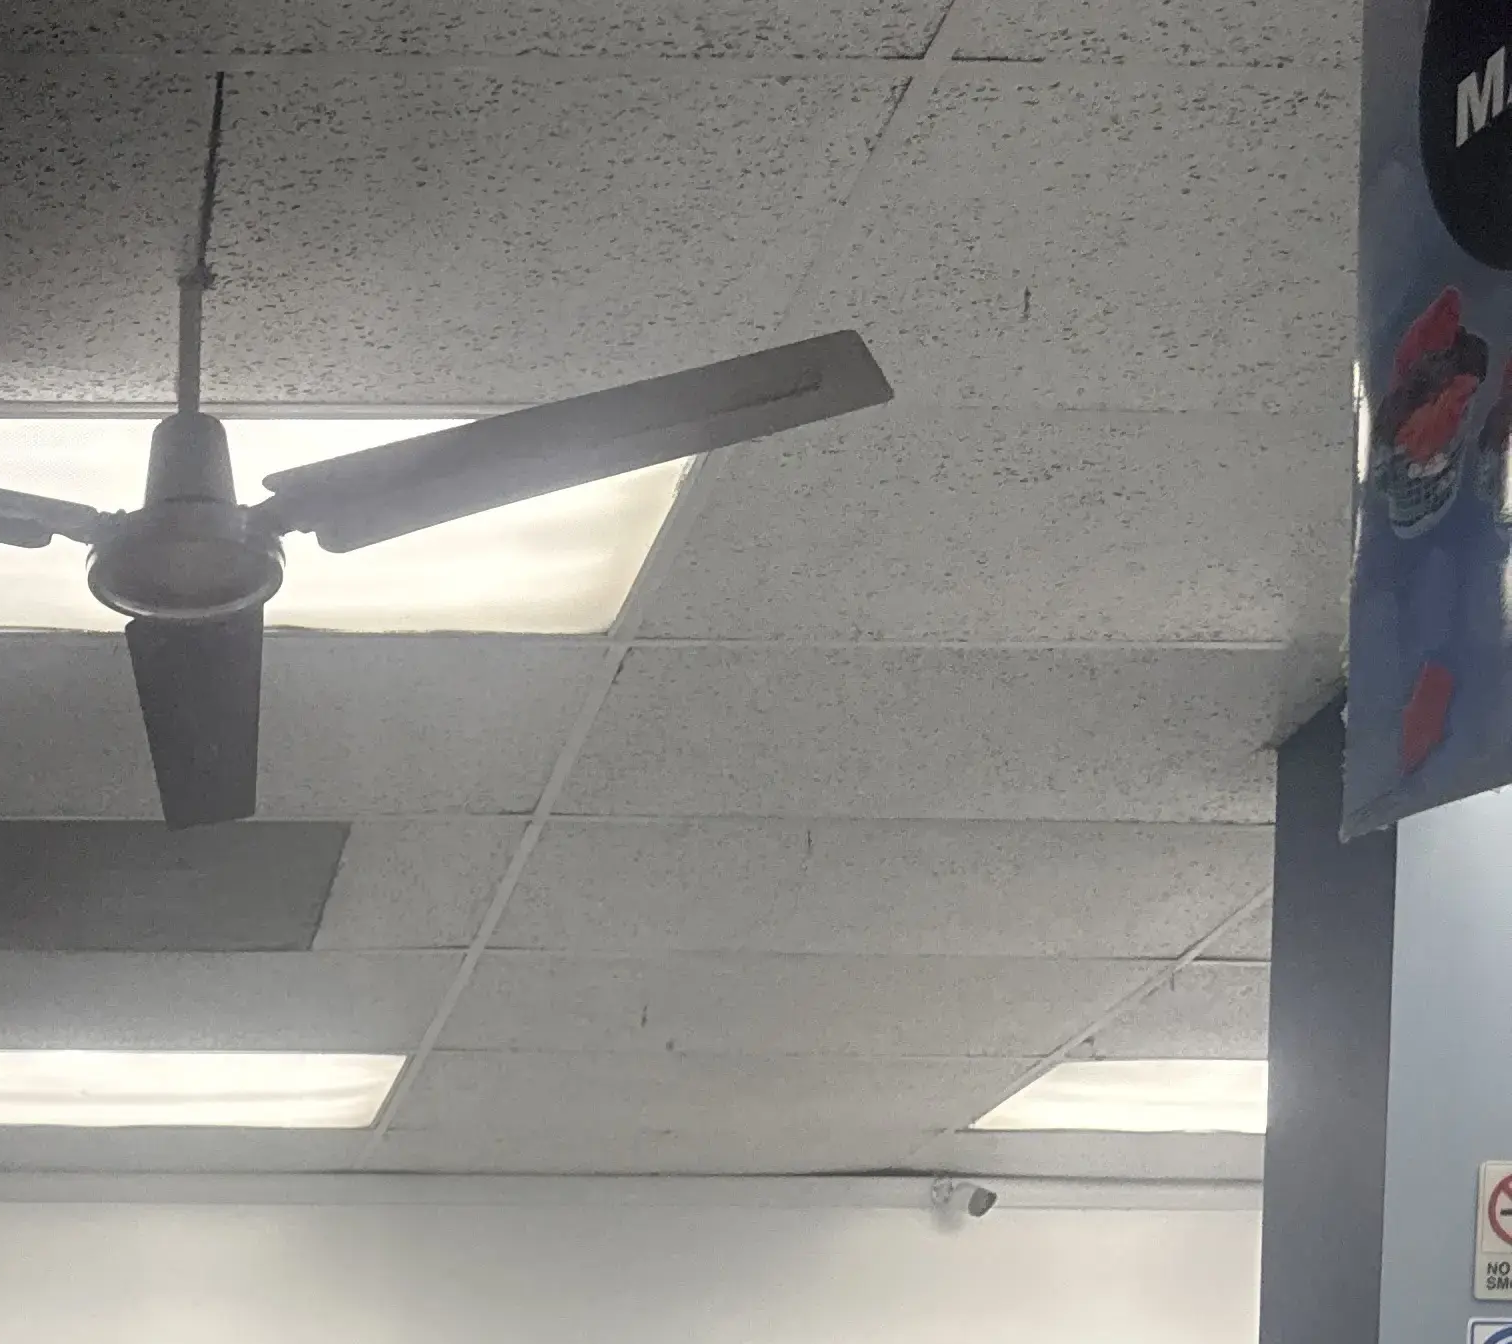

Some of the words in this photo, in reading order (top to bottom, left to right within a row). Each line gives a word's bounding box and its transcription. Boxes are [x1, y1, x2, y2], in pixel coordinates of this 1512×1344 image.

[1455, 44, 1512, 148] M
[1487, 1261, 1511, 1276] NO
[1486, 1276, 1512, 1291] SM
